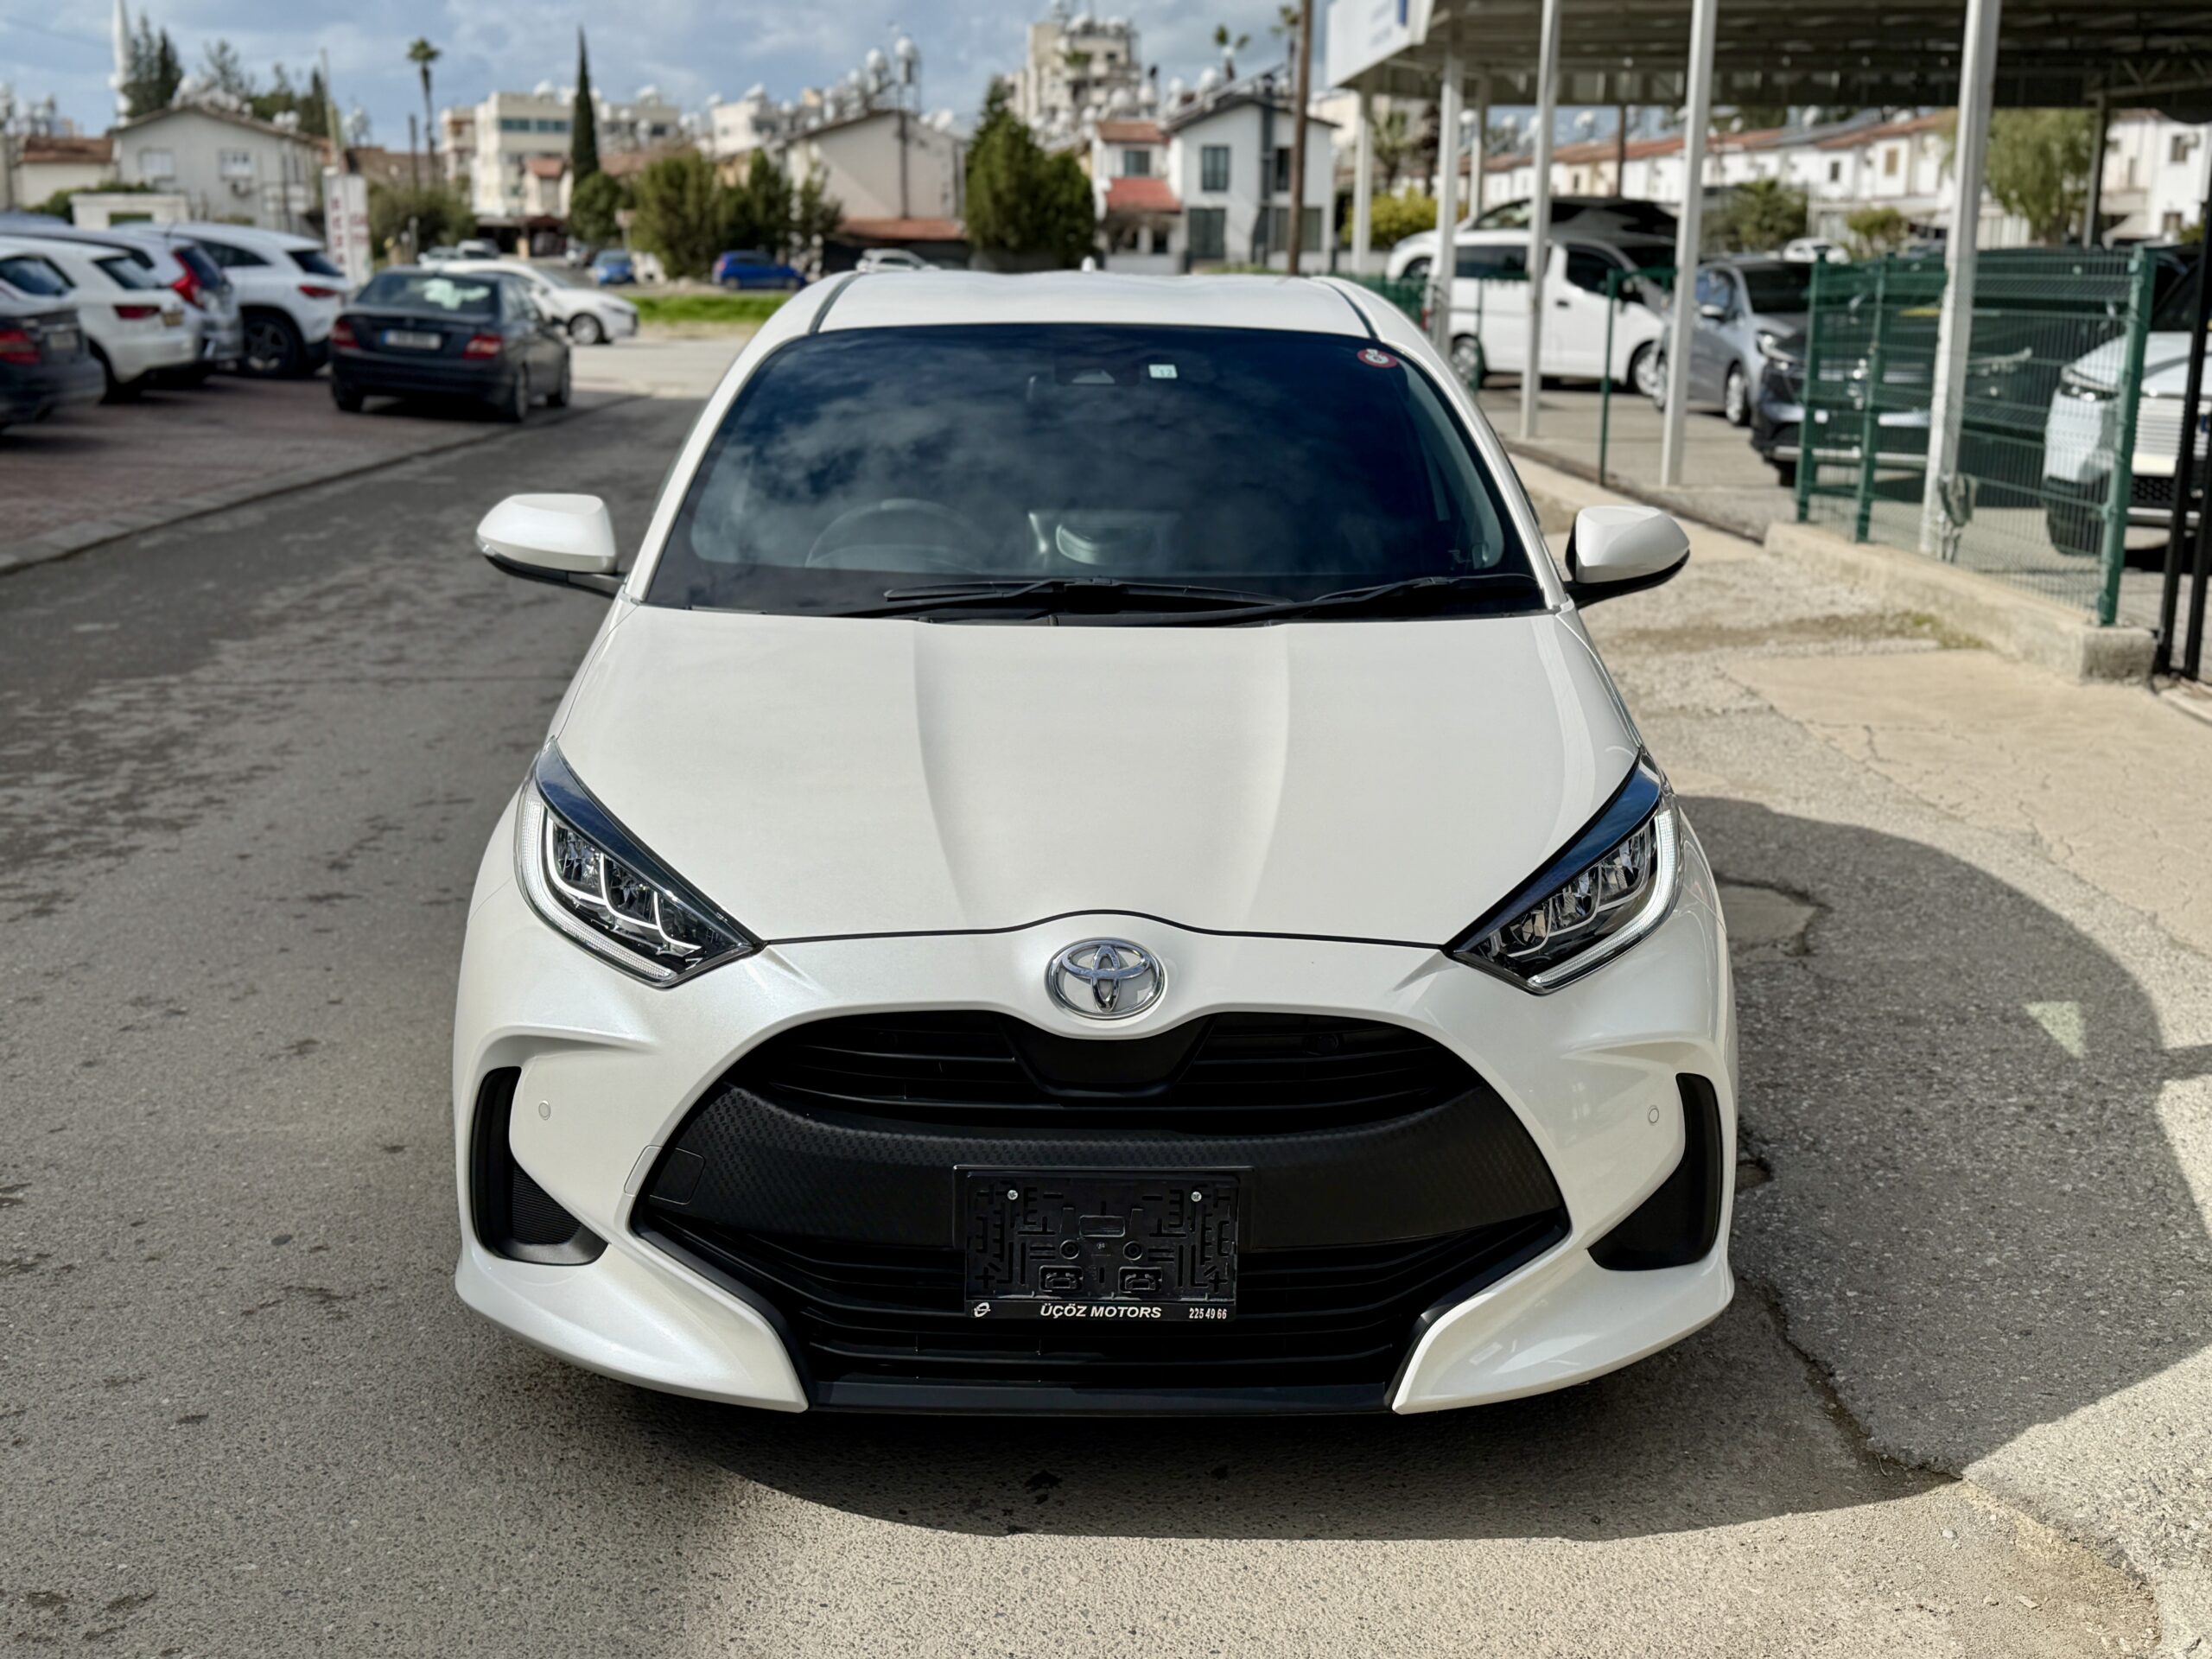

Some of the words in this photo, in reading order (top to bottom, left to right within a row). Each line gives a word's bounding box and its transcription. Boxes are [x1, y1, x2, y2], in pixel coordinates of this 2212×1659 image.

[1039, 1303, 1088, 1319] ÜÇÖZ
[1090, 1306, 1162, 1319] MOTORS
[1188, 1306, 1205, 1319] 225
[1205, 1307, 1216, 1319] 49
[1217, 1307, 1228, 1319] 66
